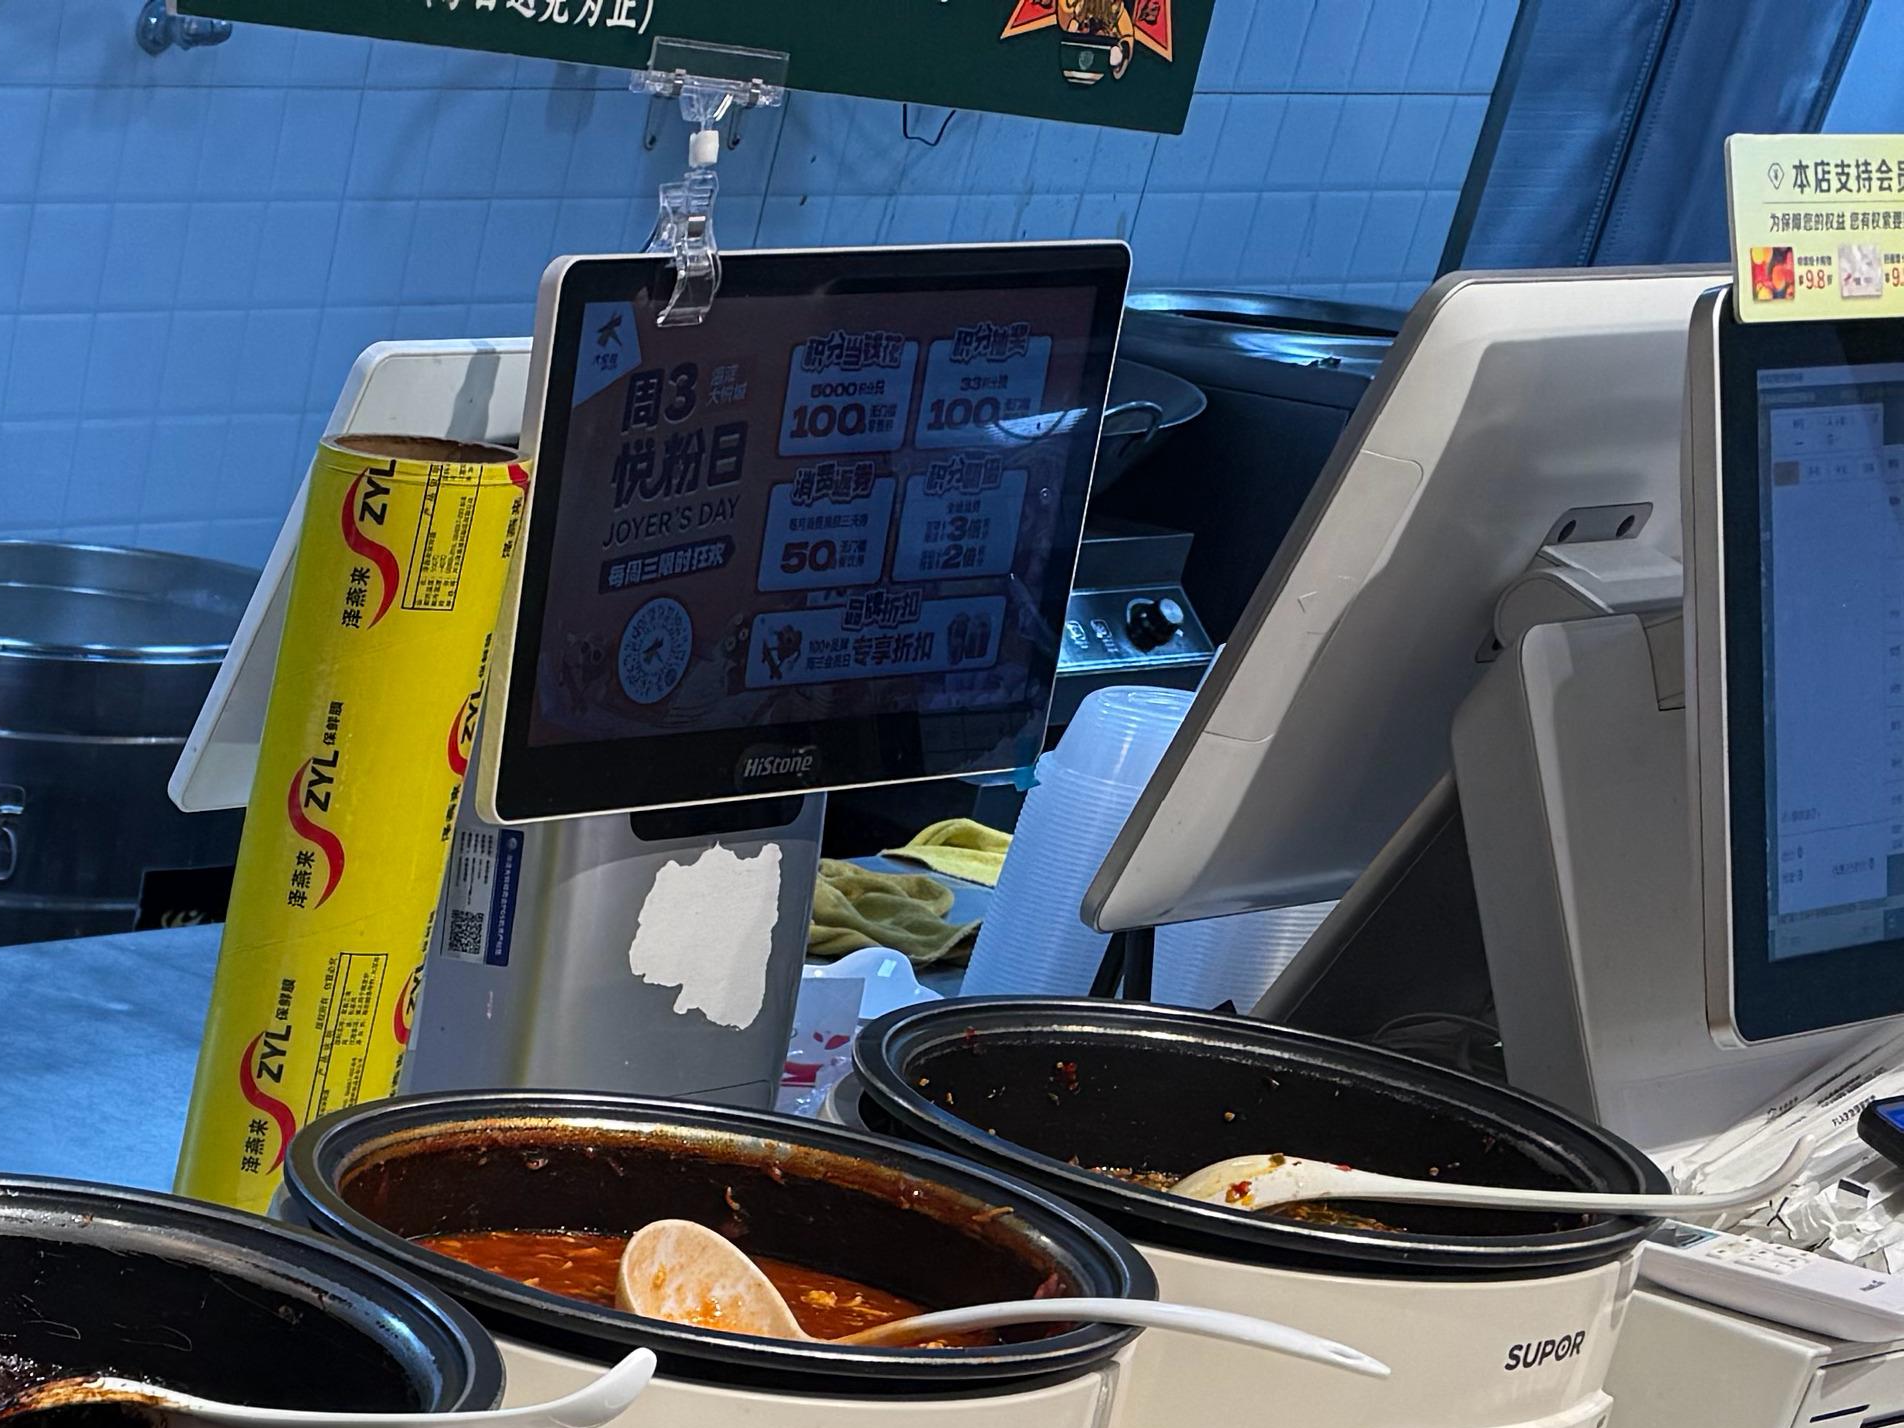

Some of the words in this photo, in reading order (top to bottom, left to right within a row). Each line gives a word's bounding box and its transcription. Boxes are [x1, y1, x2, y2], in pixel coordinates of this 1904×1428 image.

[1849, 212, 1904, 231] 您有权索要
[621, 362, 698, 434] 周3
[790, 403, 866, 438] 100
[927, 398, 1001, 431] 100
[611, 421, 748, 510] 悦粉日
[358, 459, 397, 527] ZYL
[602, 507, 692, 548] JOYER'S
[698, 495, 741, 527] DAY
[781, 540, 837, 575] 50
[342, 566, 372, 629] 泽燕来
[853, 632, 935, 666] 专享折扣
[323, 701, 345, 747] 保鲜膜
[304, 749, 341, 813] ZYL
[743, 752, 814, 779] HiStone
[288, 849, 317, 910] 泽燕来
[274, 977, 297, 1022] 保鲜膜
[256, 1023, 292, 1085] ZYL
[240, 1118, 270, 1175] 泽燕来
[1504, 1329, 1584, 1372] SUPOR
